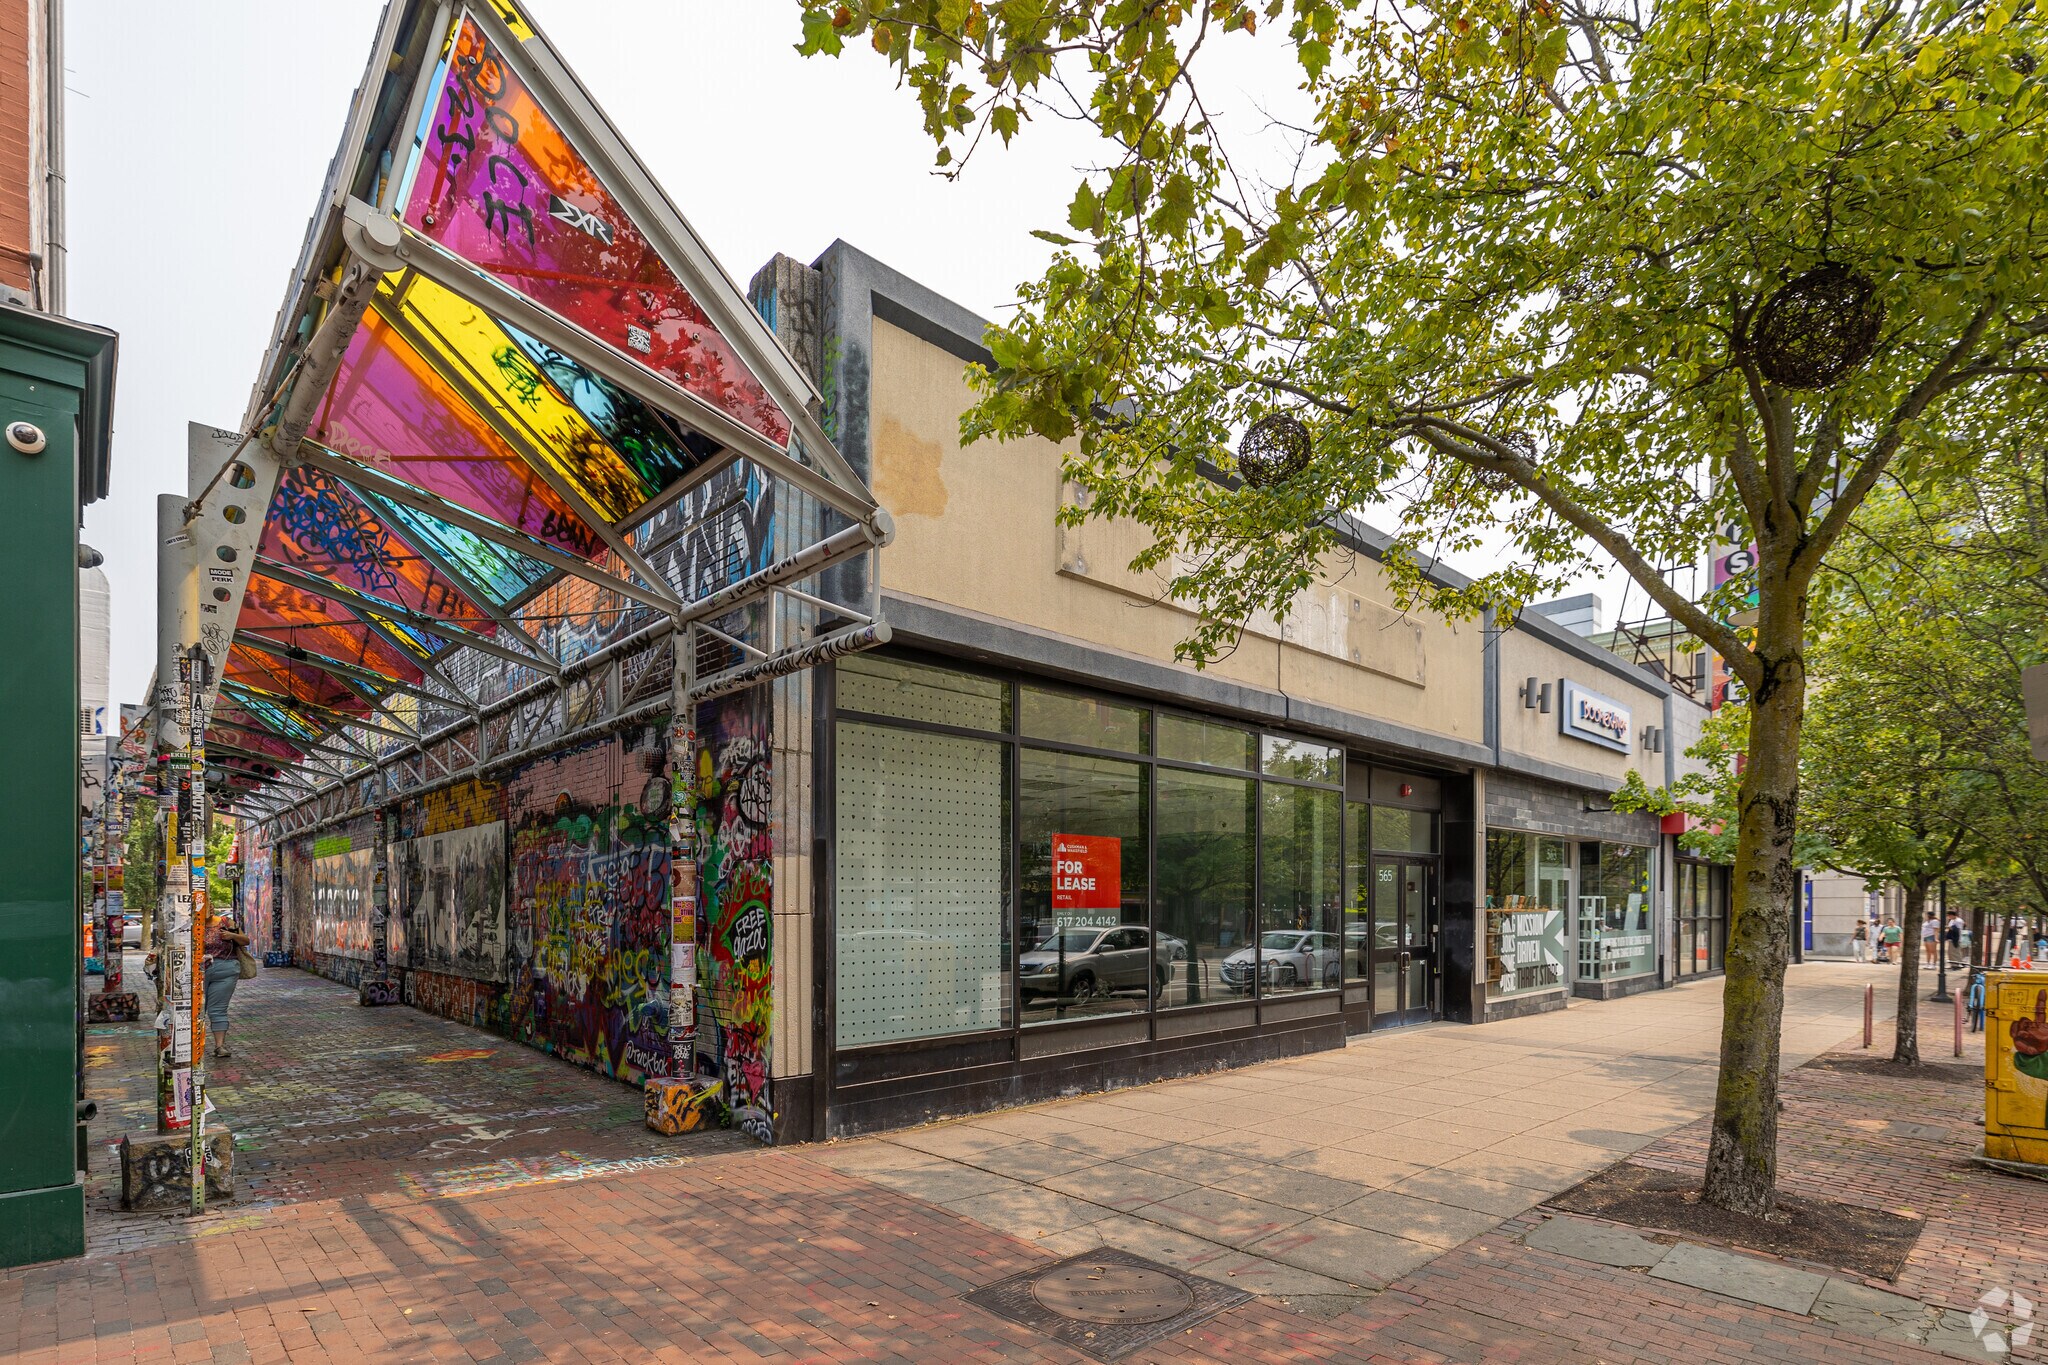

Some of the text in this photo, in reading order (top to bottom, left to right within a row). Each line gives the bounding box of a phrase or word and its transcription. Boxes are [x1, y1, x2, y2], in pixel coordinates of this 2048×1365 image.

[1057, 861, 1083, 874] FOR
[1379, 870, 1392, 881] 565
[1057, 877, 1096, 890] LEASE
[735, 908, 766, 936] FREE
[1057, 916, 1117, 927] 617 204 4142
[1517, 914, 1543, 937] MISSION
[1517, 940, 1540, 963] DRIVEN
[1517, 966, 1539, 989] THRIFT
[1540, 963, 1558, 986] STORE
